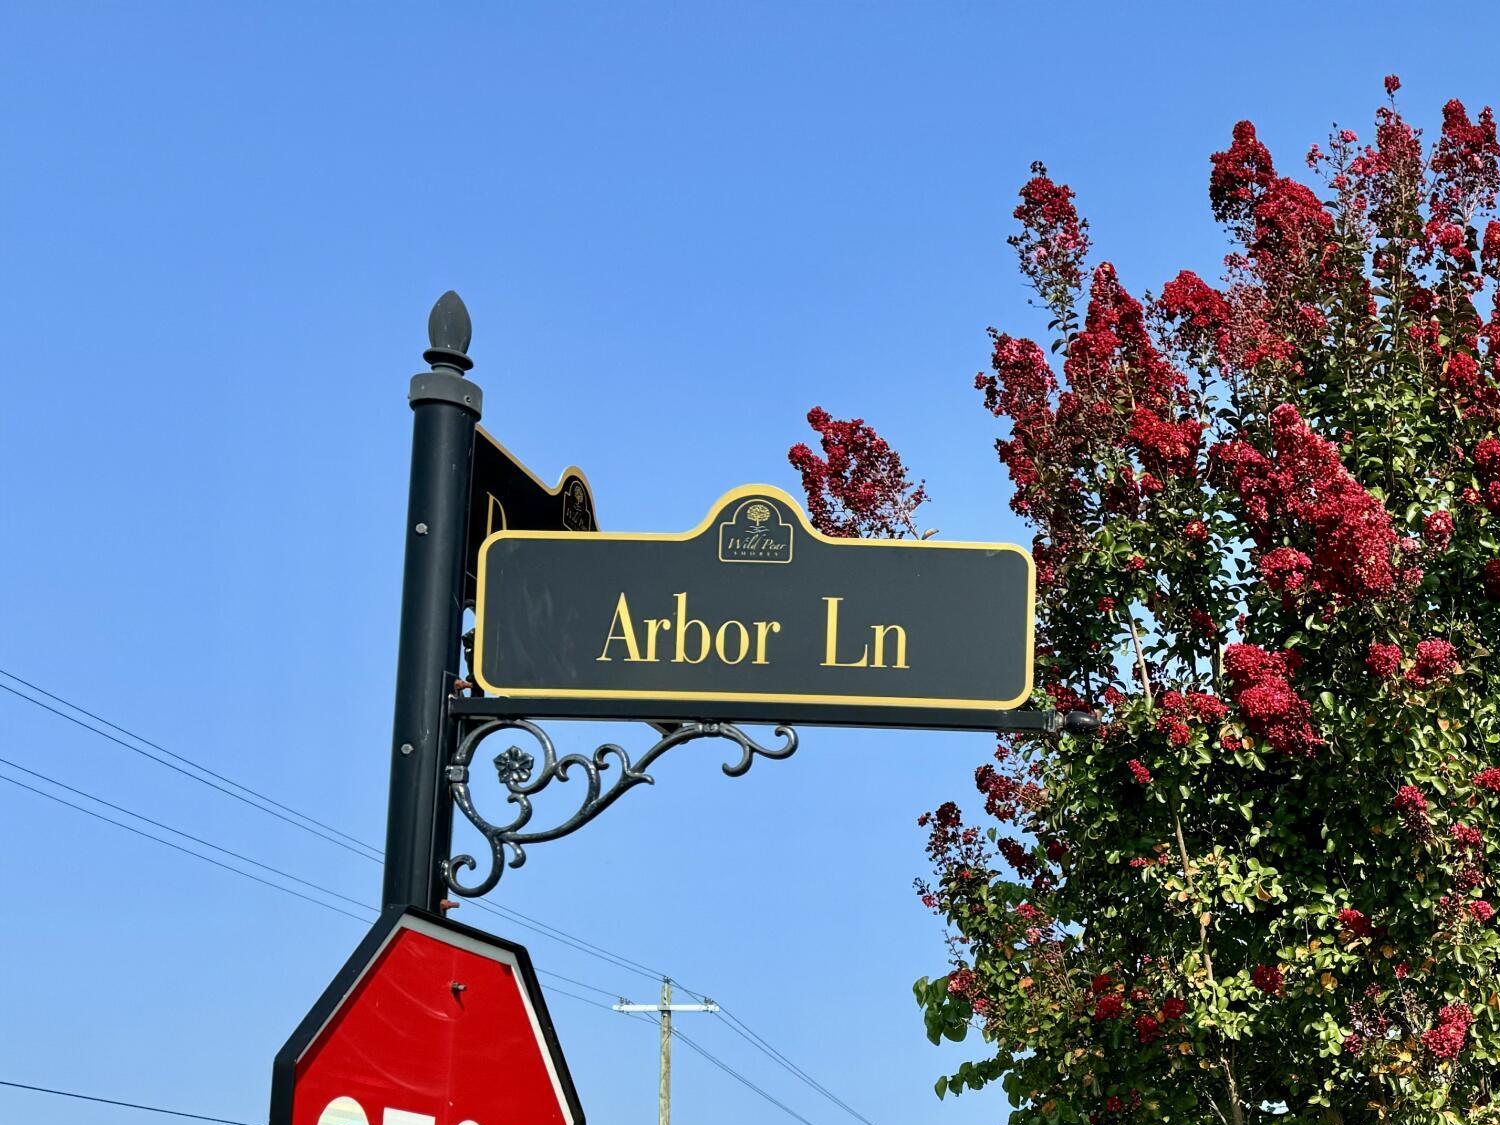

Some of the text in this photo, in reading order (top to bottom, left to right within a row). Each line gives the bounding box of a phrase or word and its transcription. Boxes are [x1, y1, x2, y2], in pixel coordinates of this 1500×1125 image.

[728, 534, 766, 549] Wild
[596, 591, 910, 669] Arbor Ln
